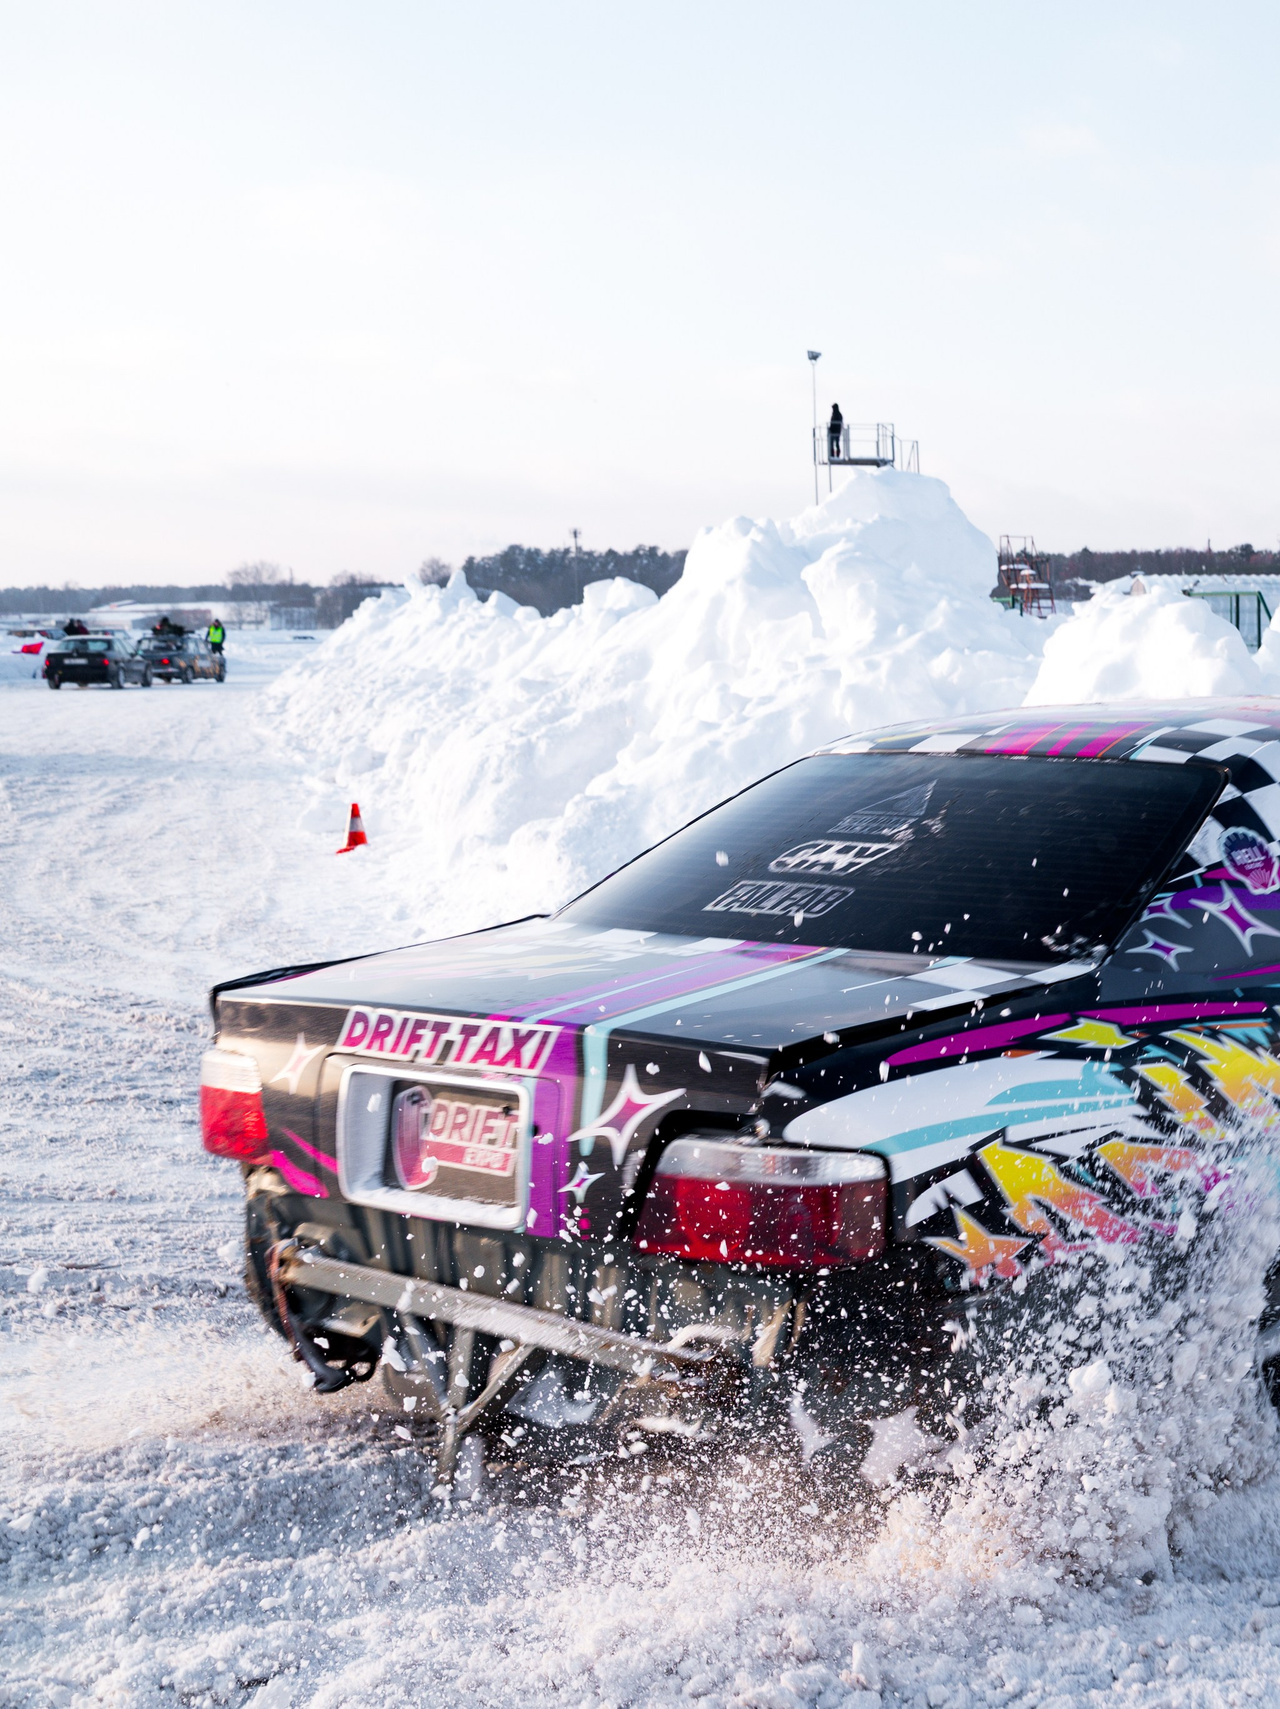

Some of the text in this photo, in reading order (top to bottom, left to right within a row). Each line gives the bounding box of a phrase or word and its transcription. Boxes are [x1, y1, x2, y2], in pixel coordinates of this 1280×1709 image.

[342, 1010, 551, 1070] DRIFT TAXI
[430, 1103, 519, 1147] DRIFT
